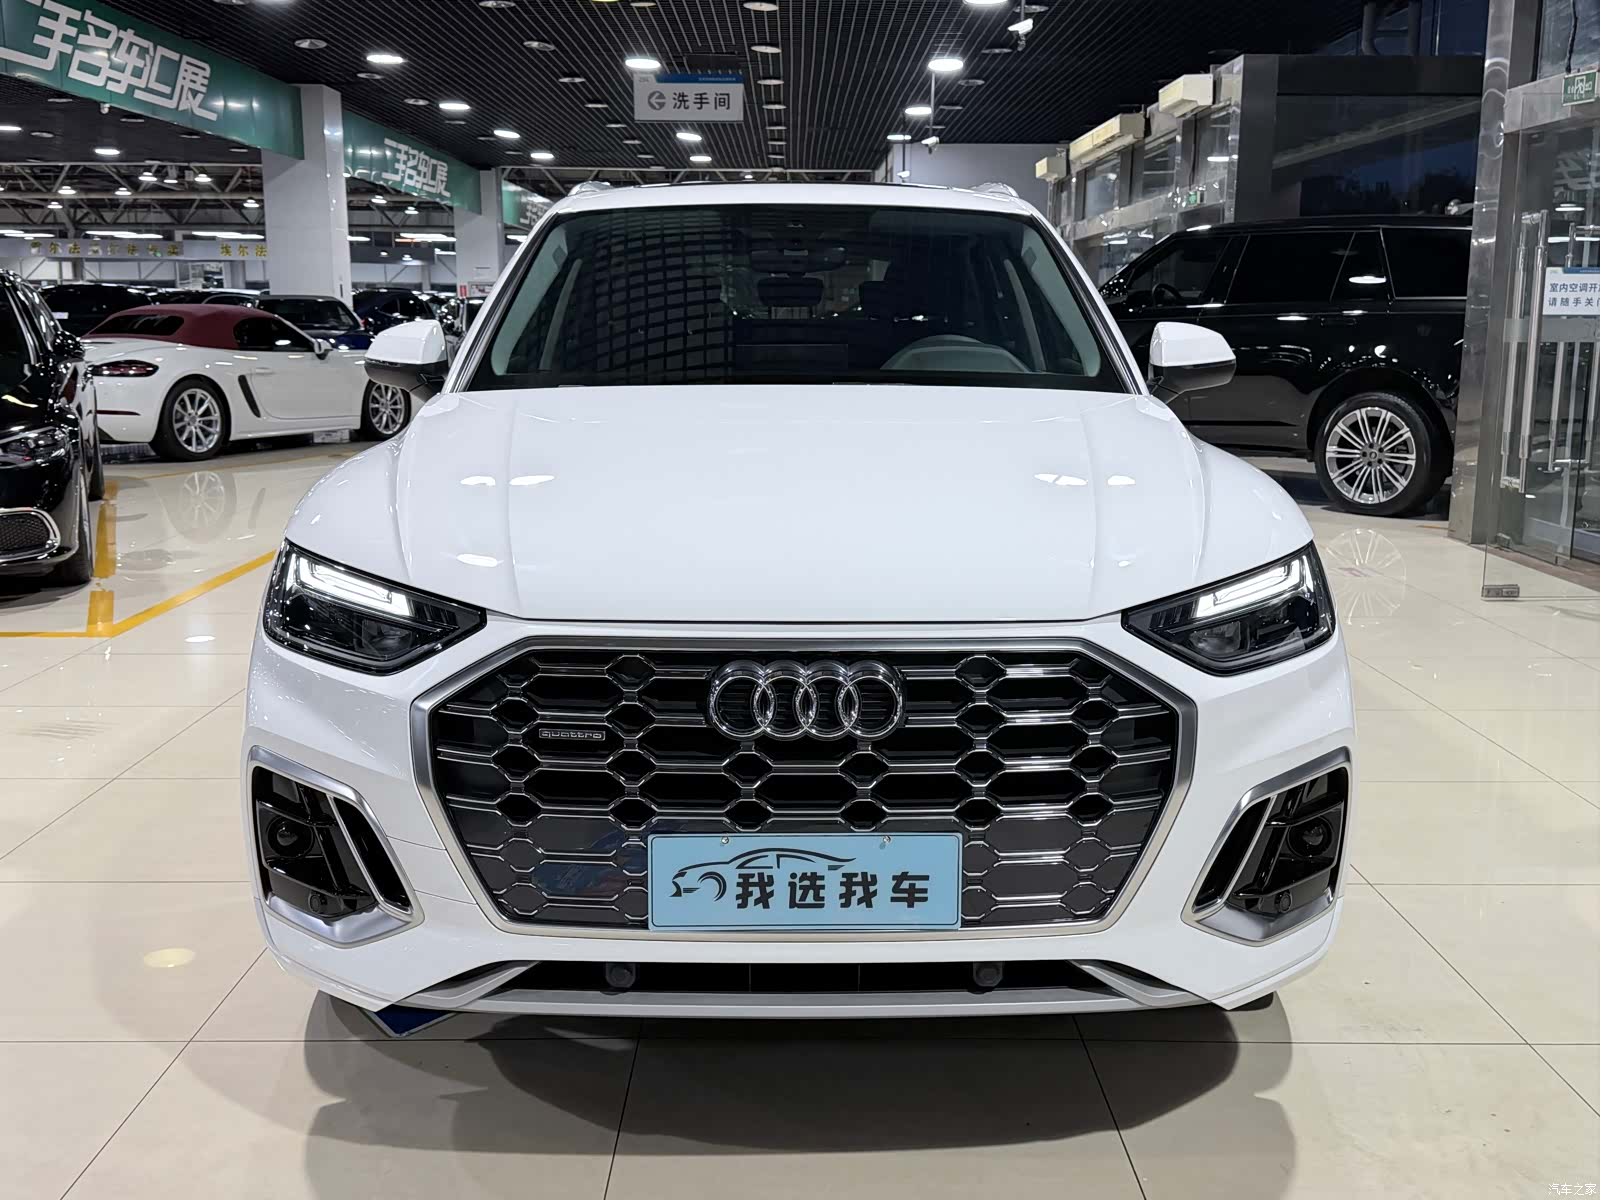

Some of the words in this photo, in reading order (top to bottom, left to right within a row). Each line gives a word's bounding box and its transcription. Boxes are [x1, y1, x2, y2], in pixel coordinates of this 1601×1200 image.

[672, 91, 731, 111] 洗手间
[382, 137, 451, 198] 二手名车汇展
[1549, 282, 1600, 293] 室内空调开
[541, 731, 602, 739] quattro
[735, 871, 931, 910] 我选我车
